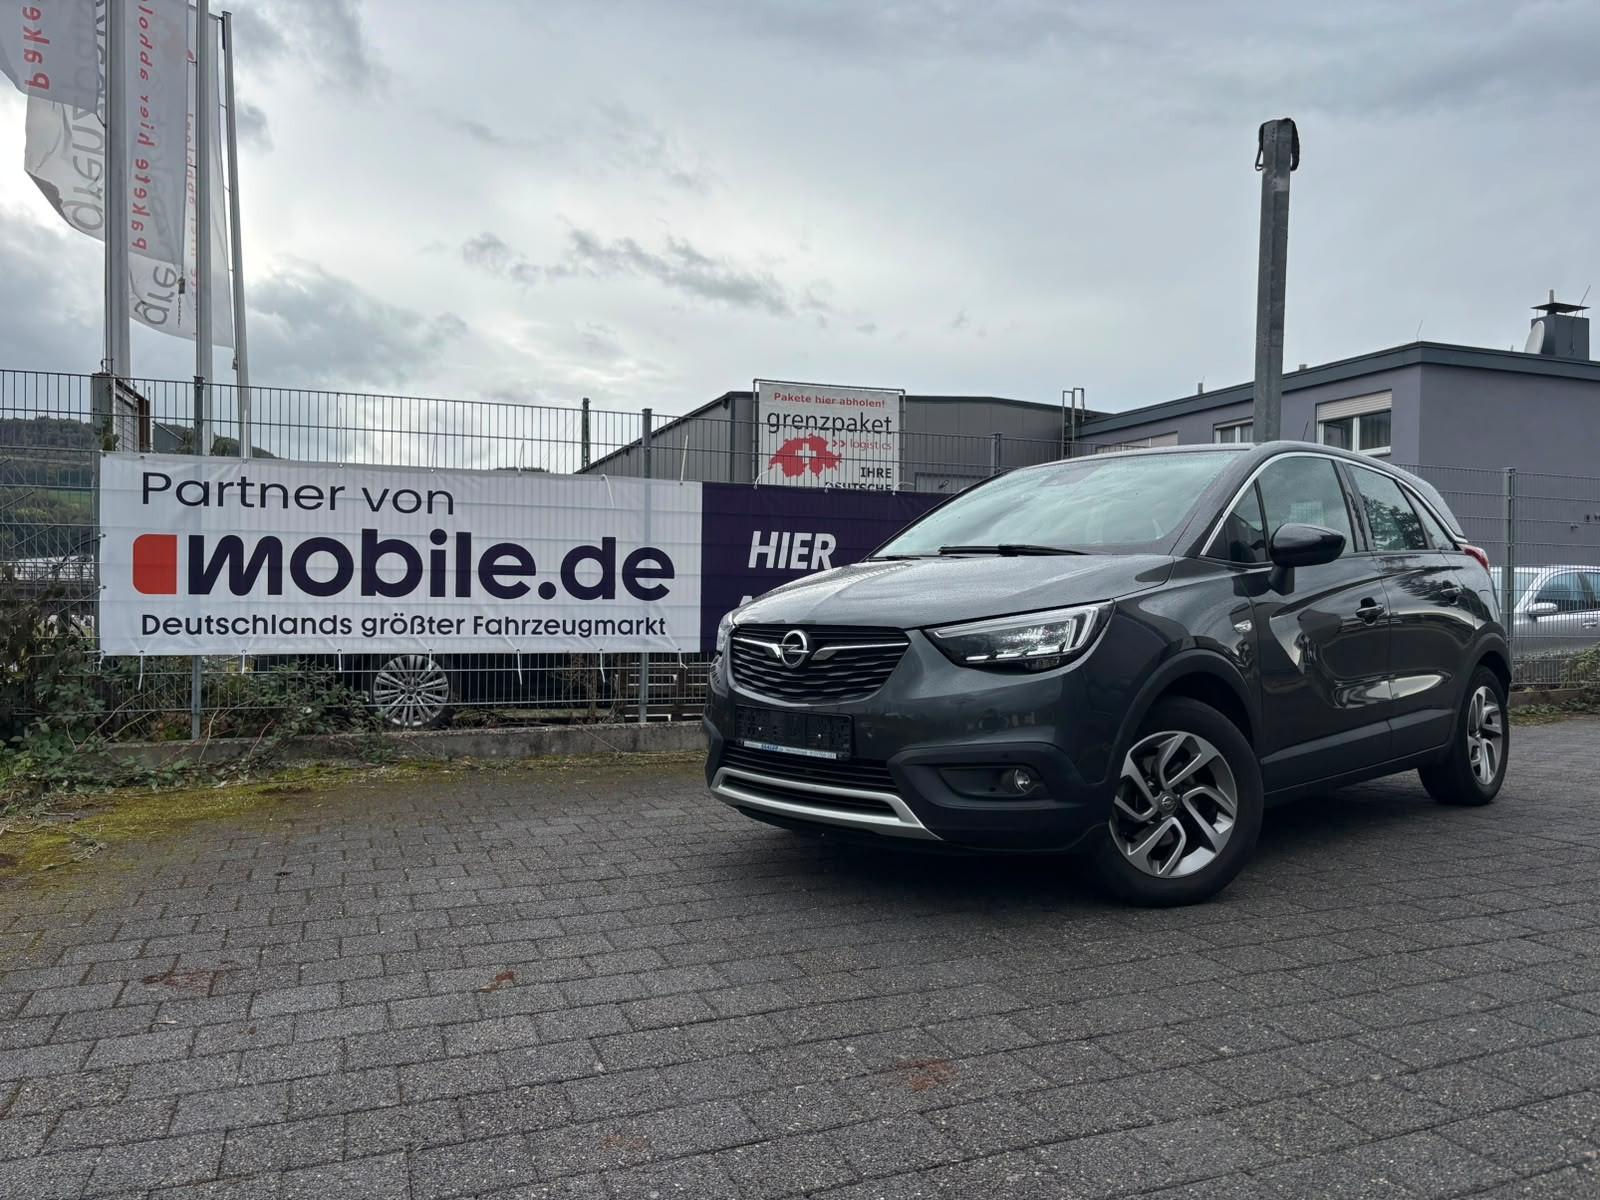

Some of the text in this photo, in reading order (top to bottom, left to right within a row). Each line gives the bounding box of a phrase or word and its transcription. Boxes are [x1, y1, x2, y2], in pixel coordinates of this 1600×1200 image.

[774, 392, 885, 408] Pakete hier abholen!
[767, 412, 892, 437] grenzpaket
[850, 438, 892, 451] logistics
[860, 467, 891, 478] IHRE
[142, 472, 454, 515] Partner von
[748, 530, 837, 570] HIER
[188, 528, 675, 600] mobile.de
[142, 613, 666, 638] Deutschlands größter Fahrzeugmarkt
